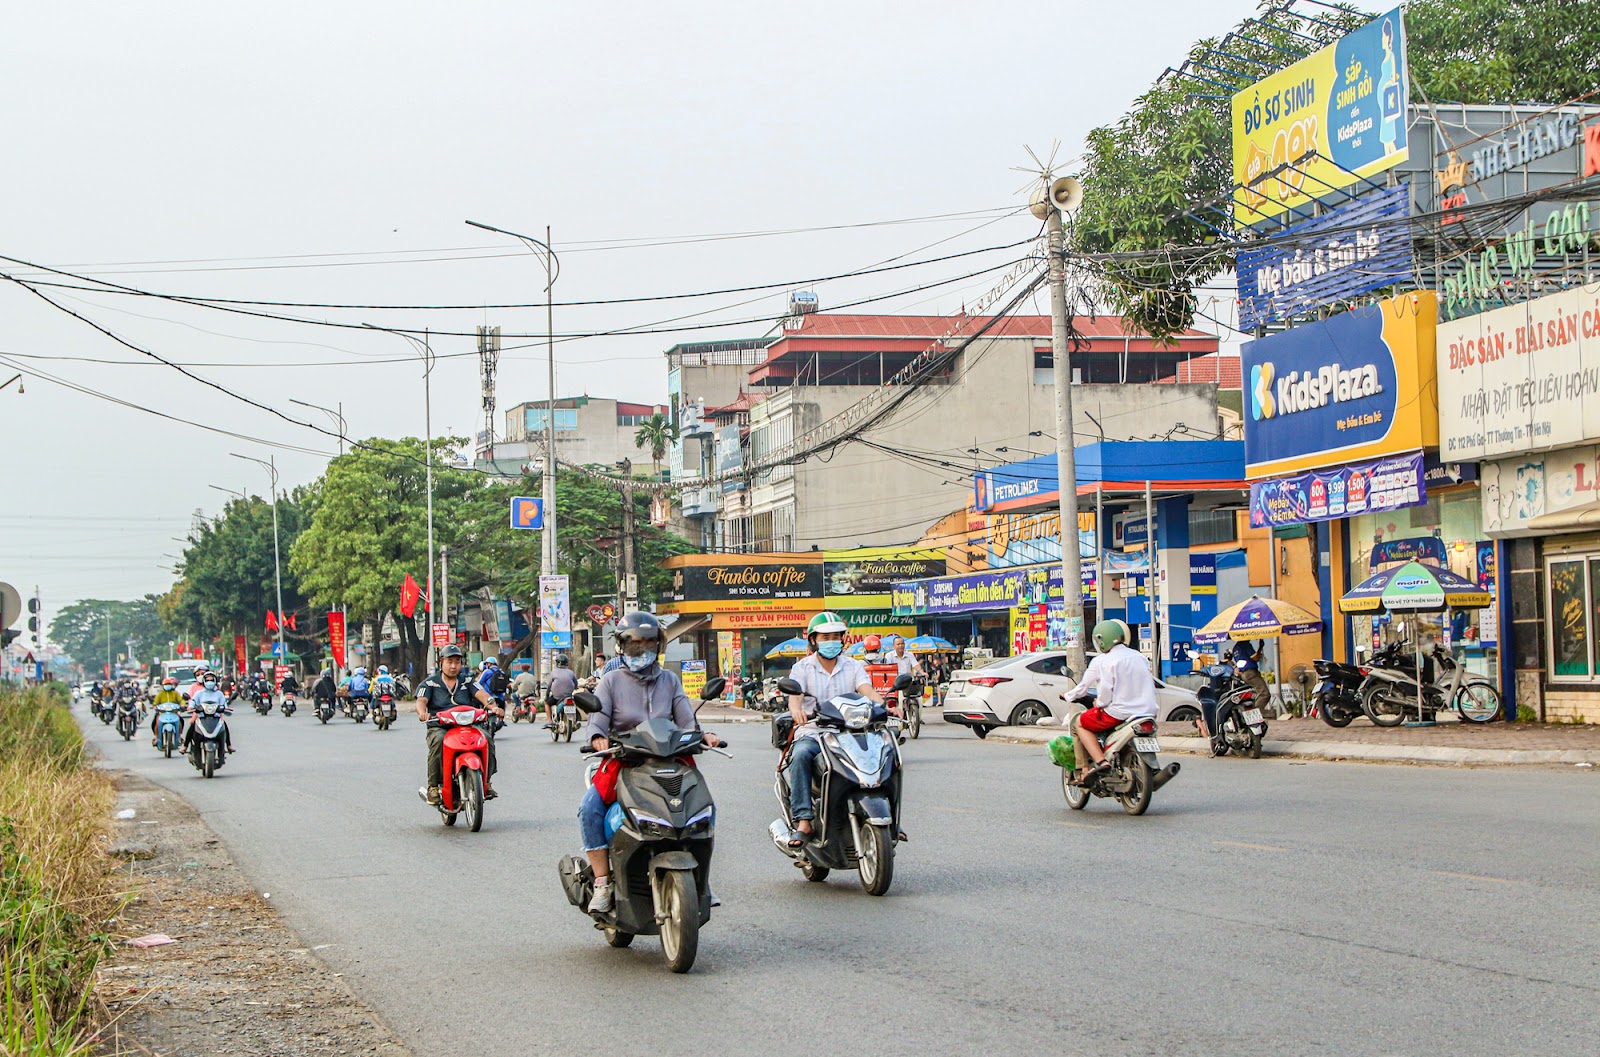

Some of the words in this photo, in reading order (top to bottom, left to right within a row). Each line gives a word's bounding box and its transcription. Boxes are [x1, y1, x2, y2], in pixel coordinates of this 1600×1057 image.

[1336, 86, 1356, 110] SINH
[1358, 69, 1372, 99] RỒI
[1244, 90, 1261, 135] ĐỒ
[1265, 91, 1281, 125] SƠ
[1284, 78, 1315, 116] SINH
[1337, 117, 1373, 142] KidsPlaza
[1257, 266, 1281, 297] Mẹ
[1313, 249, 1327, 276] &
[1449, 334, 1475, 374] ĐẶC
[1478, 325, 1505, 364] SẢN
[1515, 315, 1544, 355] HẢI
[1547, 308, 1577, 348] SẢN
[1277, 363, 1378, 416] KidsPlaza
[1461, 387, 1490, 424] NHẬN
[1493, 383, 1512, 419] ĐẶT
[1515, 377, 1536, 413] TIỆC
[1539, 373, 1562, 405] LIÊN
[1336, 419, 1346, 432] Mẹ
[1346, 414, 1358, 428] bầu
[1363, 414, 1373, 425] Em
[1373, 410, 1382, 422] bé
[1458, 436, 1466, 448] 112
[995, 479, 1039, 500] PETROLIMEX
[1311, 485, 1323, 497] 800
[1328, 480, 1345, 494] 9.999
[1347, 477, 1365, 491] 1.500
[763, 566, 806, 588] coffee
[900, 562, 926, 575] coffee
[758, 585, 770, 595] QUẢ
[958, 583, 976, 604] Giảm
[989, 579, 1004, 600] đến
[1396, 579, 1430, 587] molfix
[756, 613, 774, 622] VĂN
[777, 612, 806, 621] PHÒNG
[850, 614, 888, 624] LAPTOP
[1233, 620, 1276, 629] KidsPlaza
